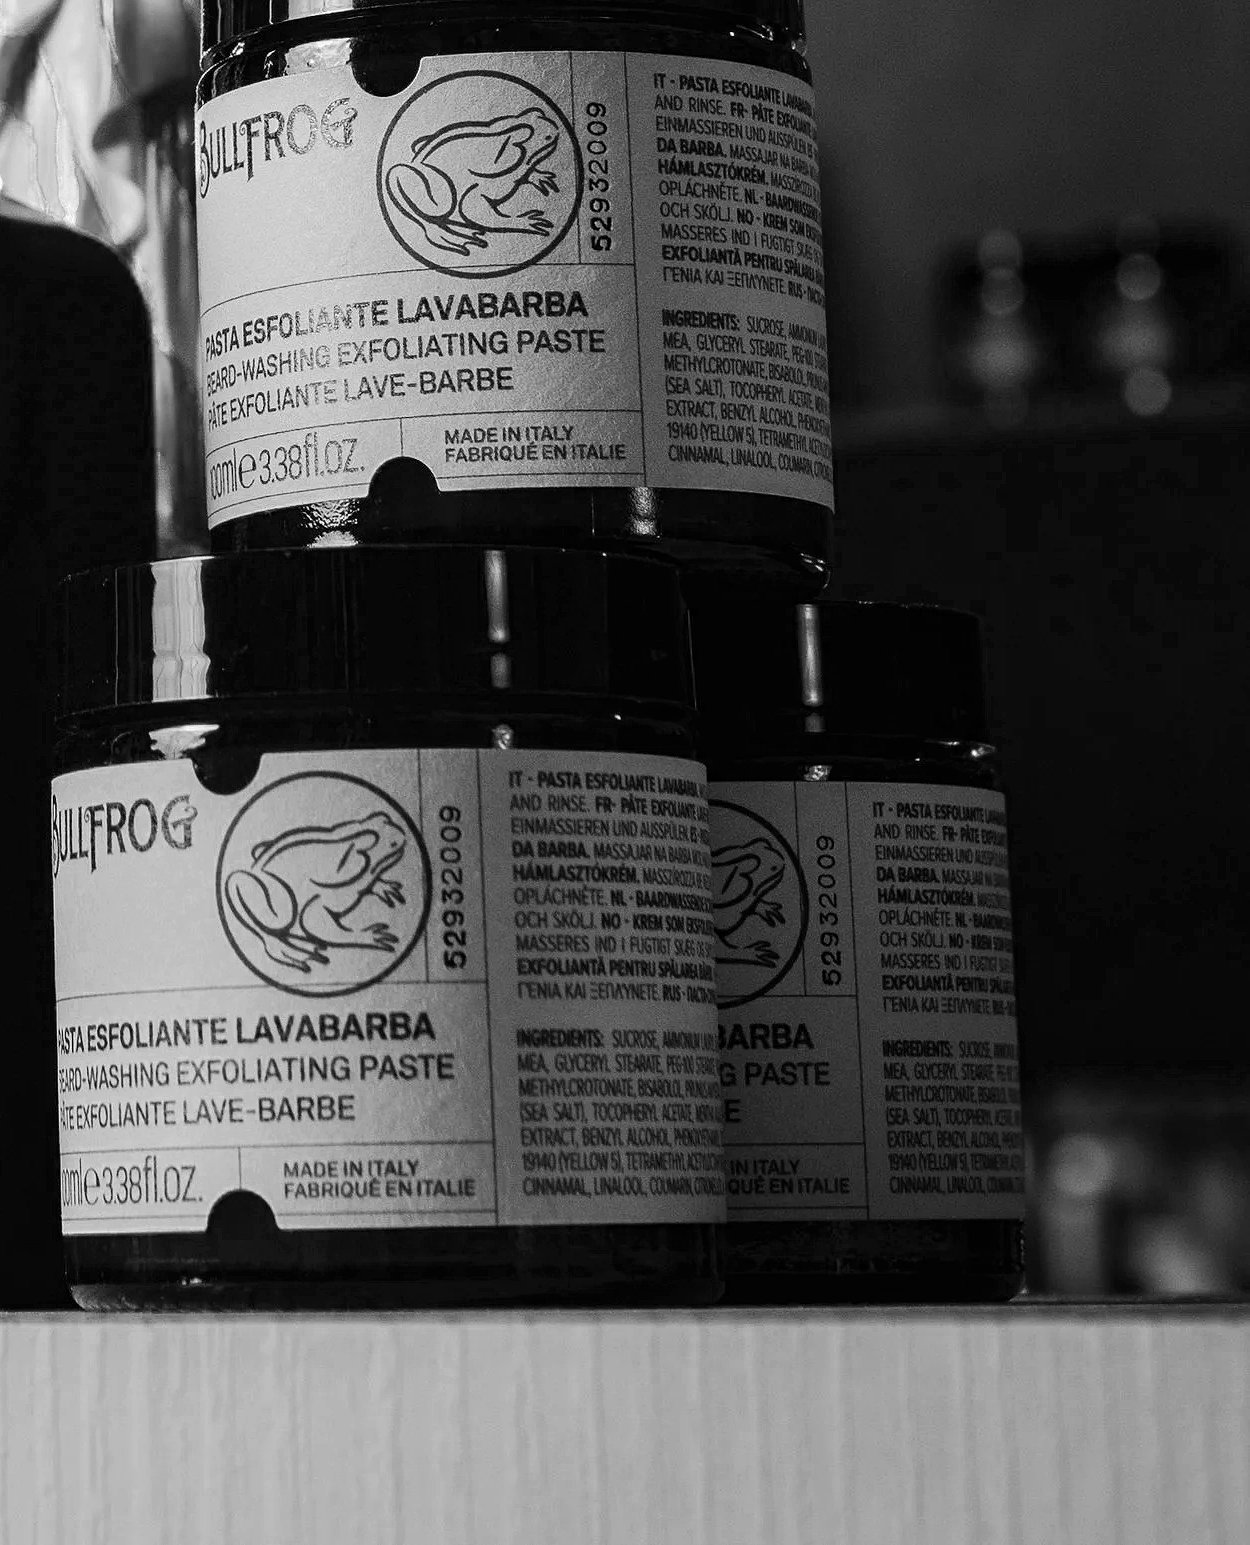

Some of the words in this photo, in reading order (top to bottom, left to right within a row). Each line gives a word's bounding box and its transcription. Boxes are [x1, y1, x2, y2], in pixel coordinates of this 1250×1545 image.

[654, 73, 666, 89] IT
[679, 75, 719, 93] PASTA
[722, 79, 781, 105] ESFOLIANTE
[654, 94, 683, 111] AND
[688, 97, 726, 116] RINSE.
[656, 116, 743, 140] EINMASSIEREN
[656, 137, 677, 153] DA
[680, 139, 727, 158] BARBA.
[586, 102, 612, 251] 52932009
[660, 202, 689, 218] OCH
[736, 208, 754, 226] NO
[762, 212, 787, 232] KREM
[661, 223, 727, 244] MASSERES
[731, 229, 750, 246] IND
[744, 251, 783, 273] PENTRU
[205, 326, 239, 362] PASTA
[243, 300, 389, 347] ESFOLIANTE
[397, 291, 589, 324] LAVABARBA
[662, 309, 740, 331] INGREDIENTS:
[696, 334, 746, 354] GLYCERYL
[207, 345, 331, 396] BEARD-WASHING
[338, 331, 508, 367] EXFOLIATING
[517, 330, 606, 354] PASTE
[230, 380, 337, 422] EXFOLIANTE
[344, 367, 514, 402] LAVE-BARBE
[720, 403, 757, 423] BENZYL
[445, 427, 498, 444] MADE
[502, 426, 521, 442] IN
[525, 425, 573, 441] ITALY
[445, 441, 538, 463] FABRIQUÉ
[542, 445, 568, 460] EN
[572, 444, 626, 460] ITALIE
[509, 770, 523, 789] IT
[537, 771, 581, 789] PASTA
[585, 772, 655, 793] ESFOLIANTE
[510, 794, 542, 811] AND
[874, 824, 900, 839] AND
[511, 840, 534, 859] DA
[876, 866, 895, 882] DA
[440, 806, 467, 969] 52932009
[515, 911, 548, 929] OCH
[601, 912, 621, 930] NO
[816, 835, 842, 986] 52932009
[515, 935, 590, 952] MASSERES
[87, 1017, 228, 1052] ESFOLIANTE
[236, 1012, 436, 1044] LAVABARBA
[177, 1056, 350, 1085] EXFOLIATING
[359, 1053, 455, 1080] PASTE
[744, 1062, 831, 1086] PASTE
[76, 1100, 176, 1129] EXFOLIANTE
[183, 1095, 355, 1125] LAVE-BARBE
[284, 1160, 338, 1178] MADE
[343, 1160, 362, 1177] IN
[368, 1159, 419, 1177] ITALY
[730, 1160, 749, 1175] IN
[753, 1159, 800, 1175] ITALY
[284, 1177, 381, 1199] FABRIQUÉ
[385, 1179, 412, 1196] EN
[417, 1178, 476, 1197] ITALIE
[769, 1178, 794, 1194] EN
[798, 1178, 850, 1194] ITALIE
